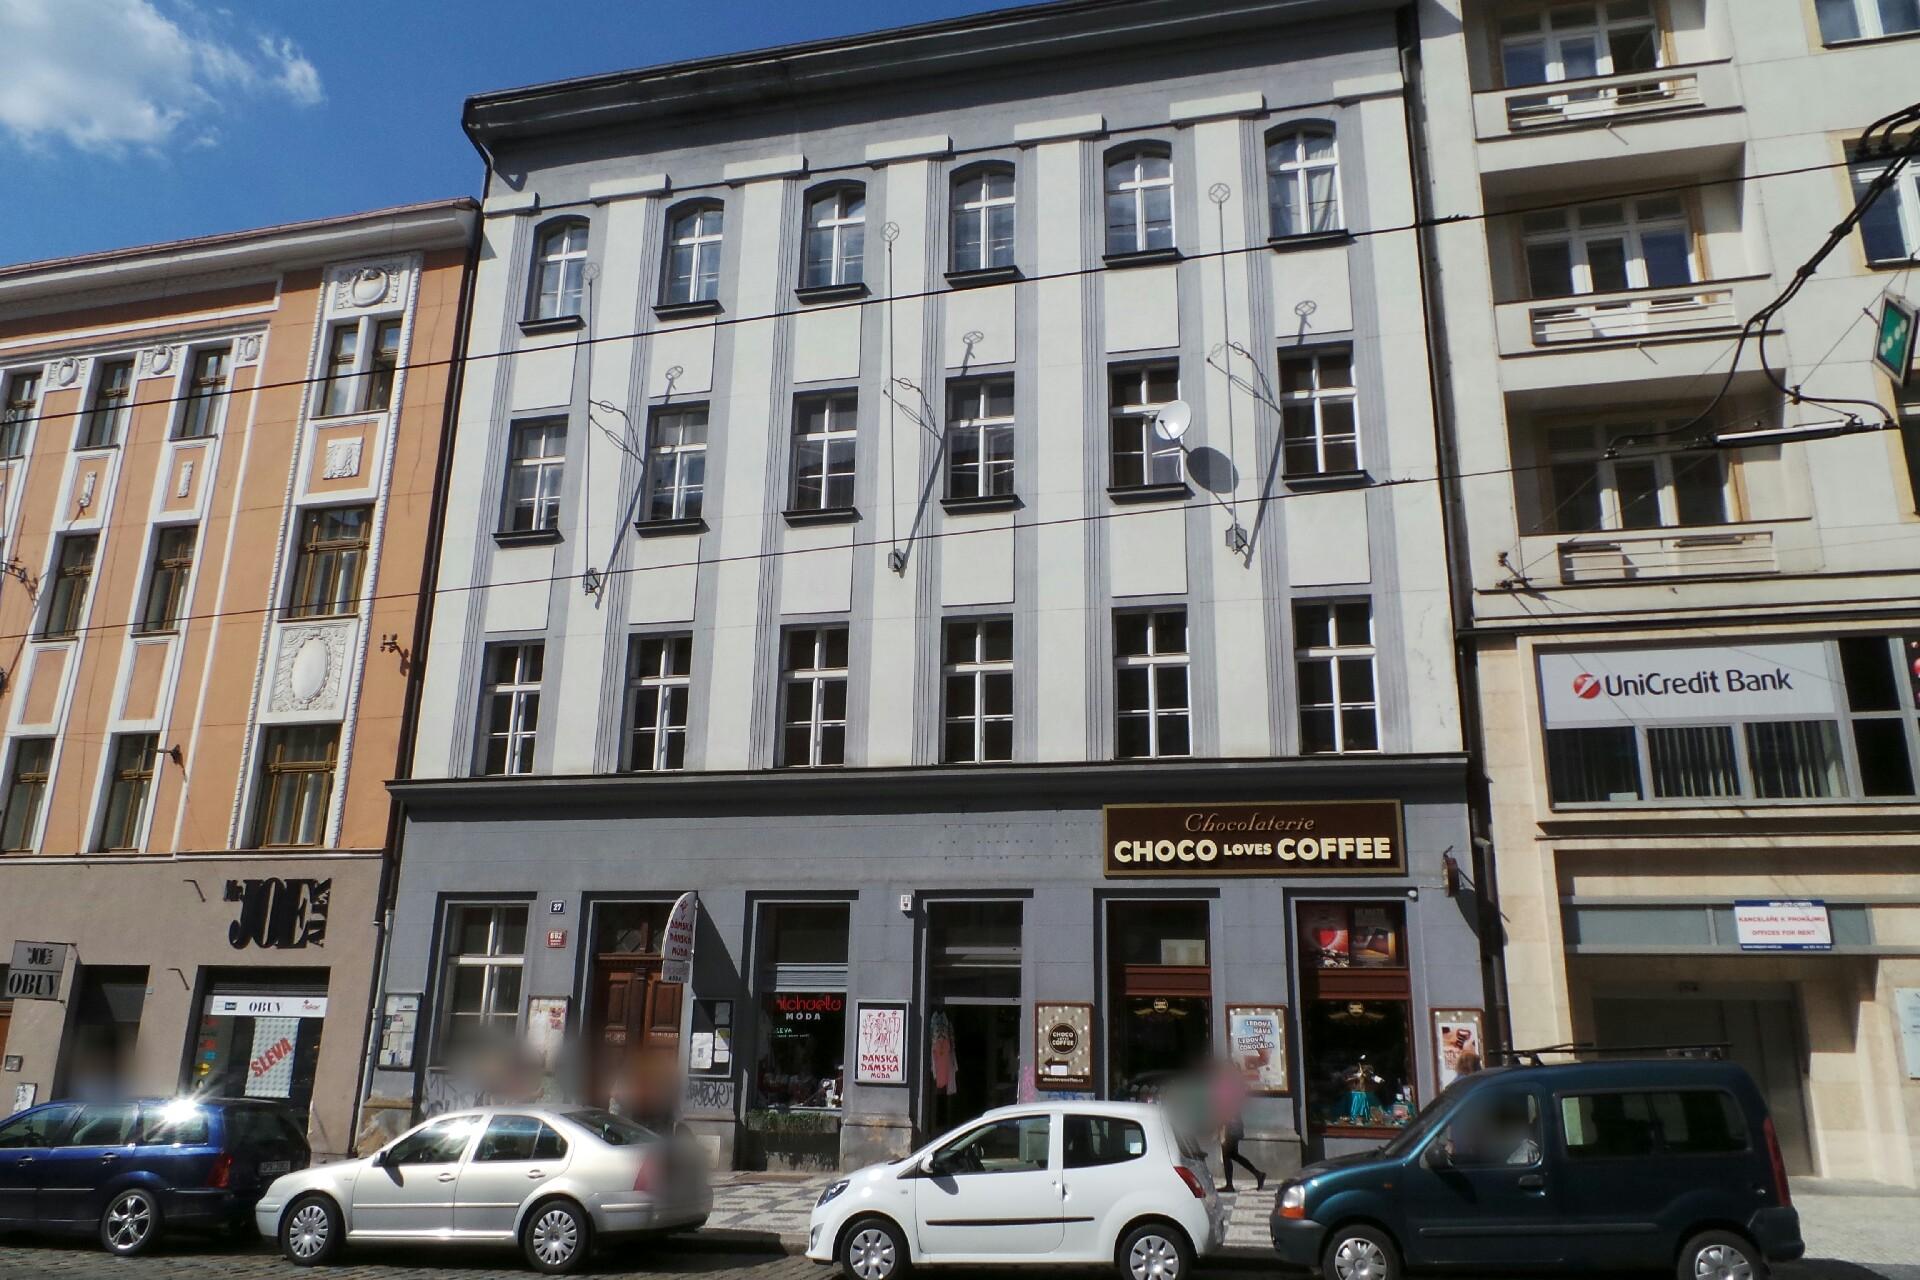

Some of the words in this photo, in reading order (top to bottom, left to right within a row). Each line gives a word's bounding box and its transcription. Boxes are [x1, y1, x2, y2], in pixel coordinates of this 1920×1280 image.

[1605, 671, 1720, 697] UniCredit
[1725, 668, 1794, 692] Bank
[1185, 812, 1316, 833] Chocolaterie
[1114, 839, 1218, 863] CHOCO
[1223, 843, 1273, 857] LOVES
[1277, 837, 1392, 861] COFFEE
[228, 877, 318, 949] JOE
[553, 903, 562, 911] 27
[9, 973, 54, 996] OBUV
[249, 1001, 281, 1013] OBUV
[250, 1037, 293, 1077] SLEVA
